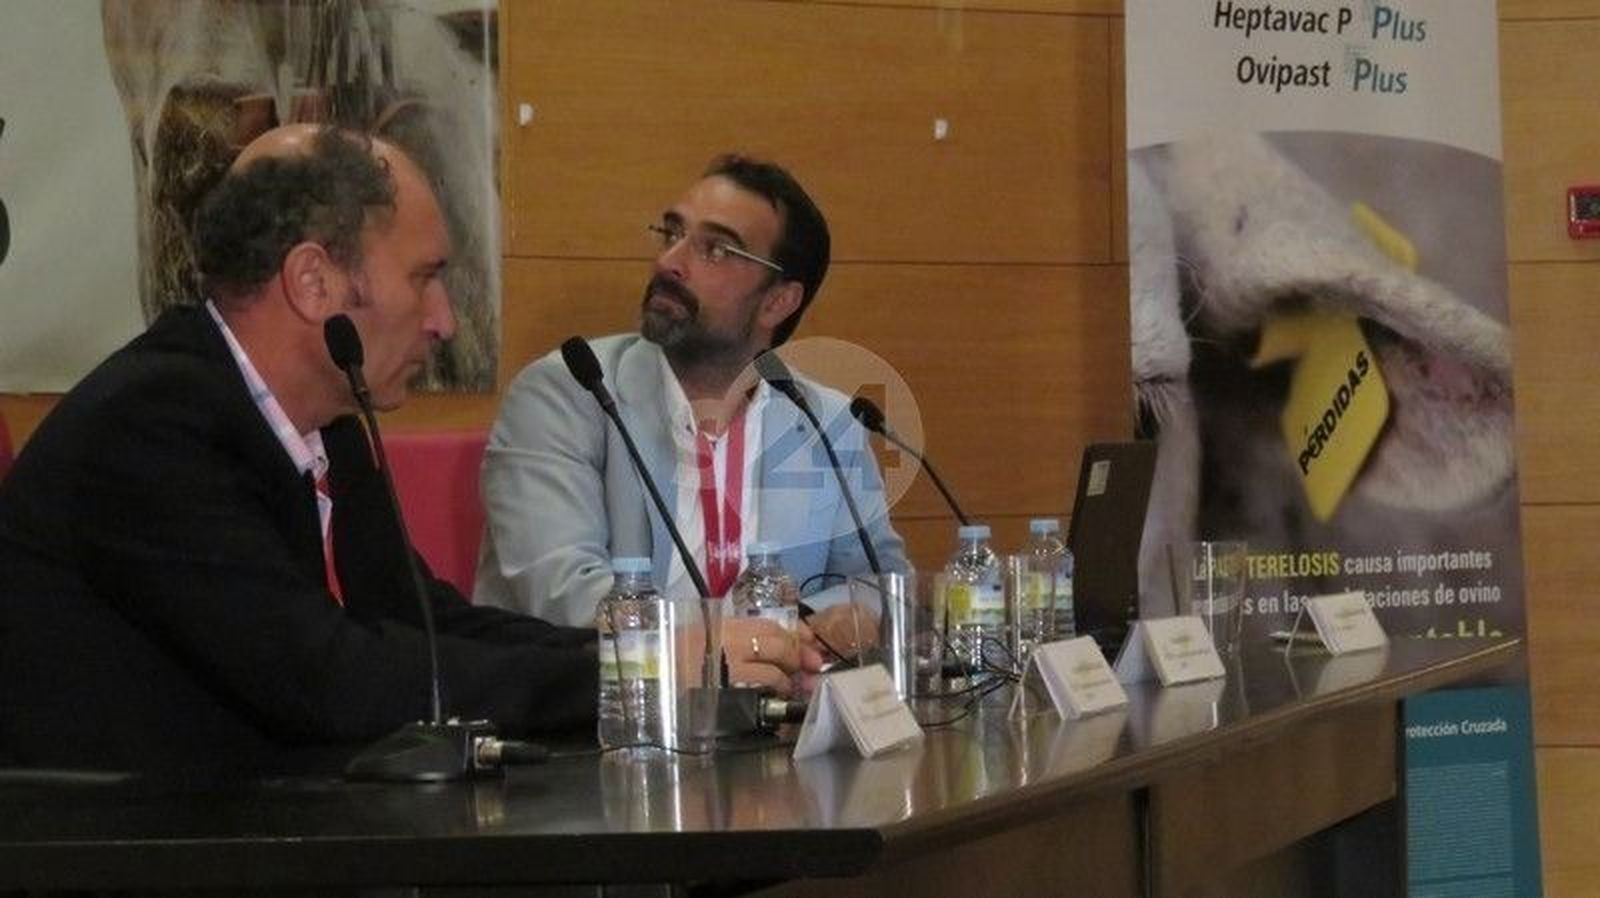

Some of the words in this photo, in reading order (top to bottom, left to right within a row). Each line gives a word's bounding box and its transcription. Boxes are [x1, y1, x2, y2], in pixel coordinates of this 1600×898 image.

[1214, 0, 1330, 38] Heptavac
[1337, 8, 1352, 34] P
[1372, 6, 1426, 42] Plus
[1236, 55, 1331, 93] Ovipast
[1353, 58, 1408, 94] Plus
[1344, 556, 1393, 574] causa
[1397, 550, 1493, 577] importantes
[1257, 596, 1279, 614] en
[1435, 583, 1455, 605] de
[1458, 581, 1502, 603] ovino
[1405, 720, 1460, 739] rotección
